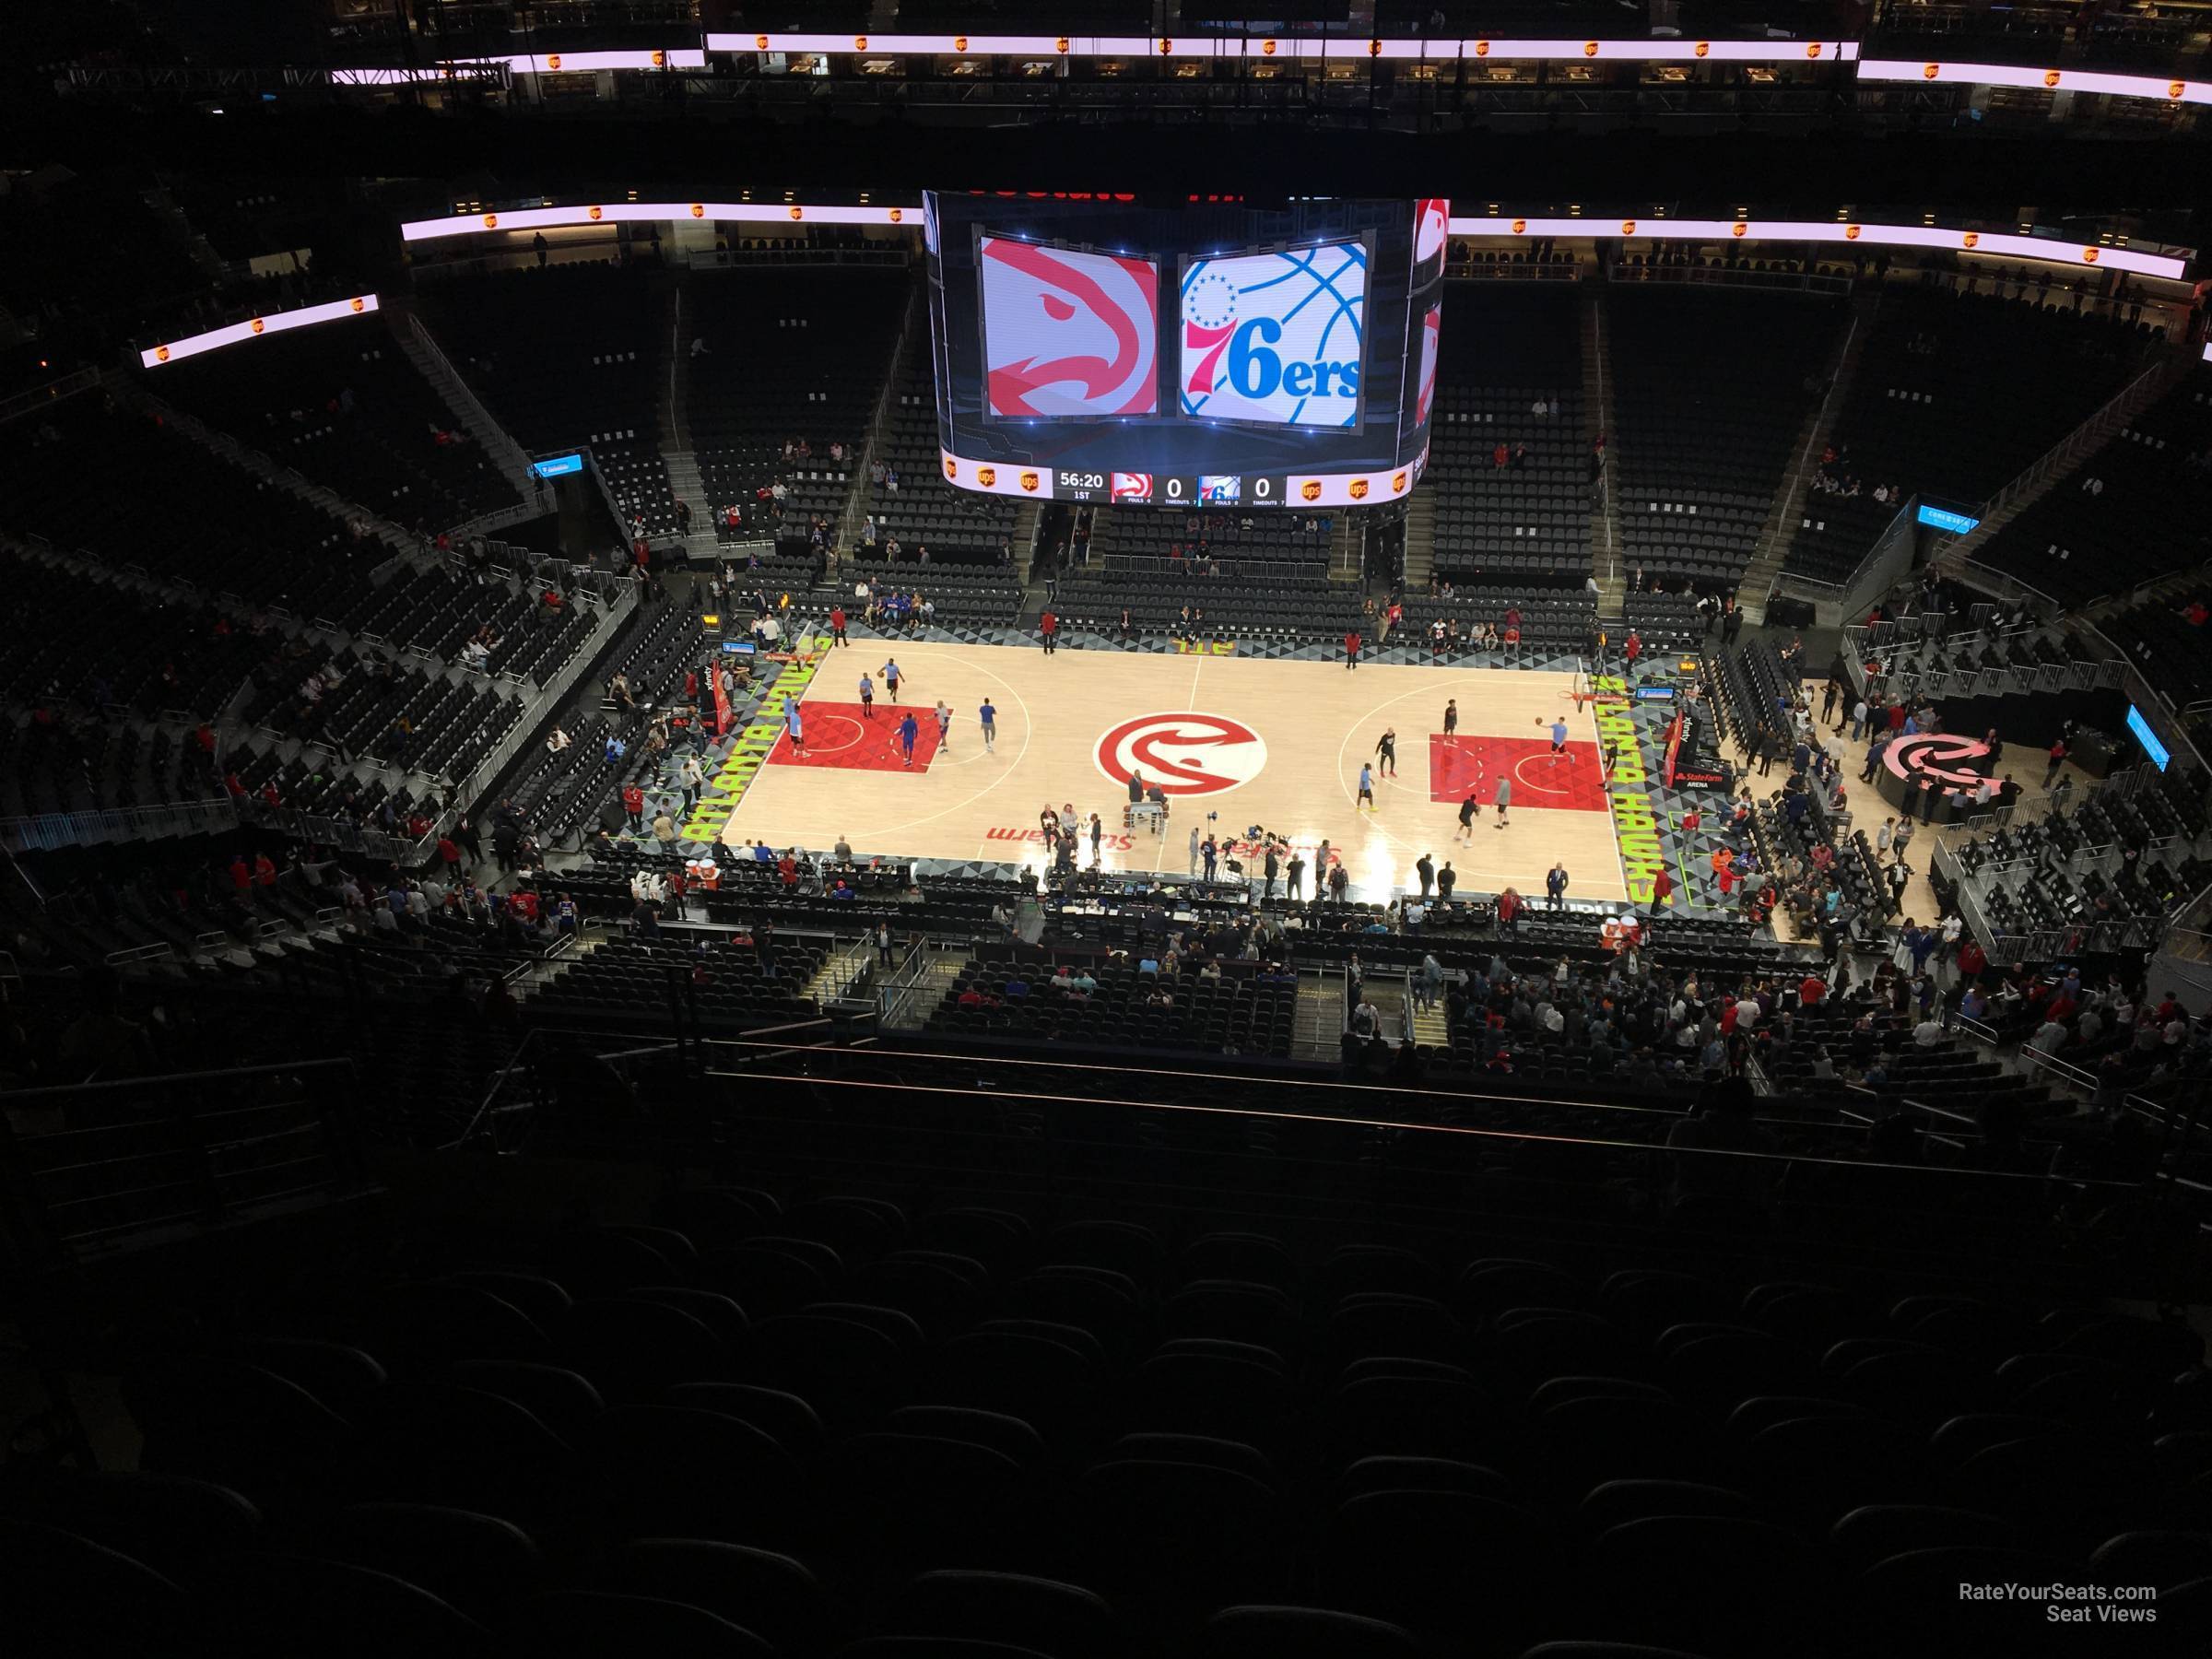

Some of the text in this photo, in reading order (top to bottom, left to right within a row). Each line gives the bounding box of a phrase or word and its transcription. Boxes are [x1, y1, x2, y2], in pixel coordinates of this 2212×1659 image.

[1186, 316, 1359, 399] 76ers
[979, 472, 994, 485] ups
[1021, 477, 1038, 489] ups
[1061, 473, 1103, 488] 56:20
[1167, 478, 1182, 498] 0
[1255, 478, 1270, 498] 0
[1075, 490, 1090, 500] 1ST
[1303, 486, 1320, 499] ups
[1350, 484, 1368, 497] ups
[705, 665, 713, 691] xfinity
[1591, 676, 1646, 783] ALANTA
[1680, 716, 1693, 743] xfinity
[680, 724, 781, 841] ATLANTA
[1611, 793, 1674, 905] HAWKS
